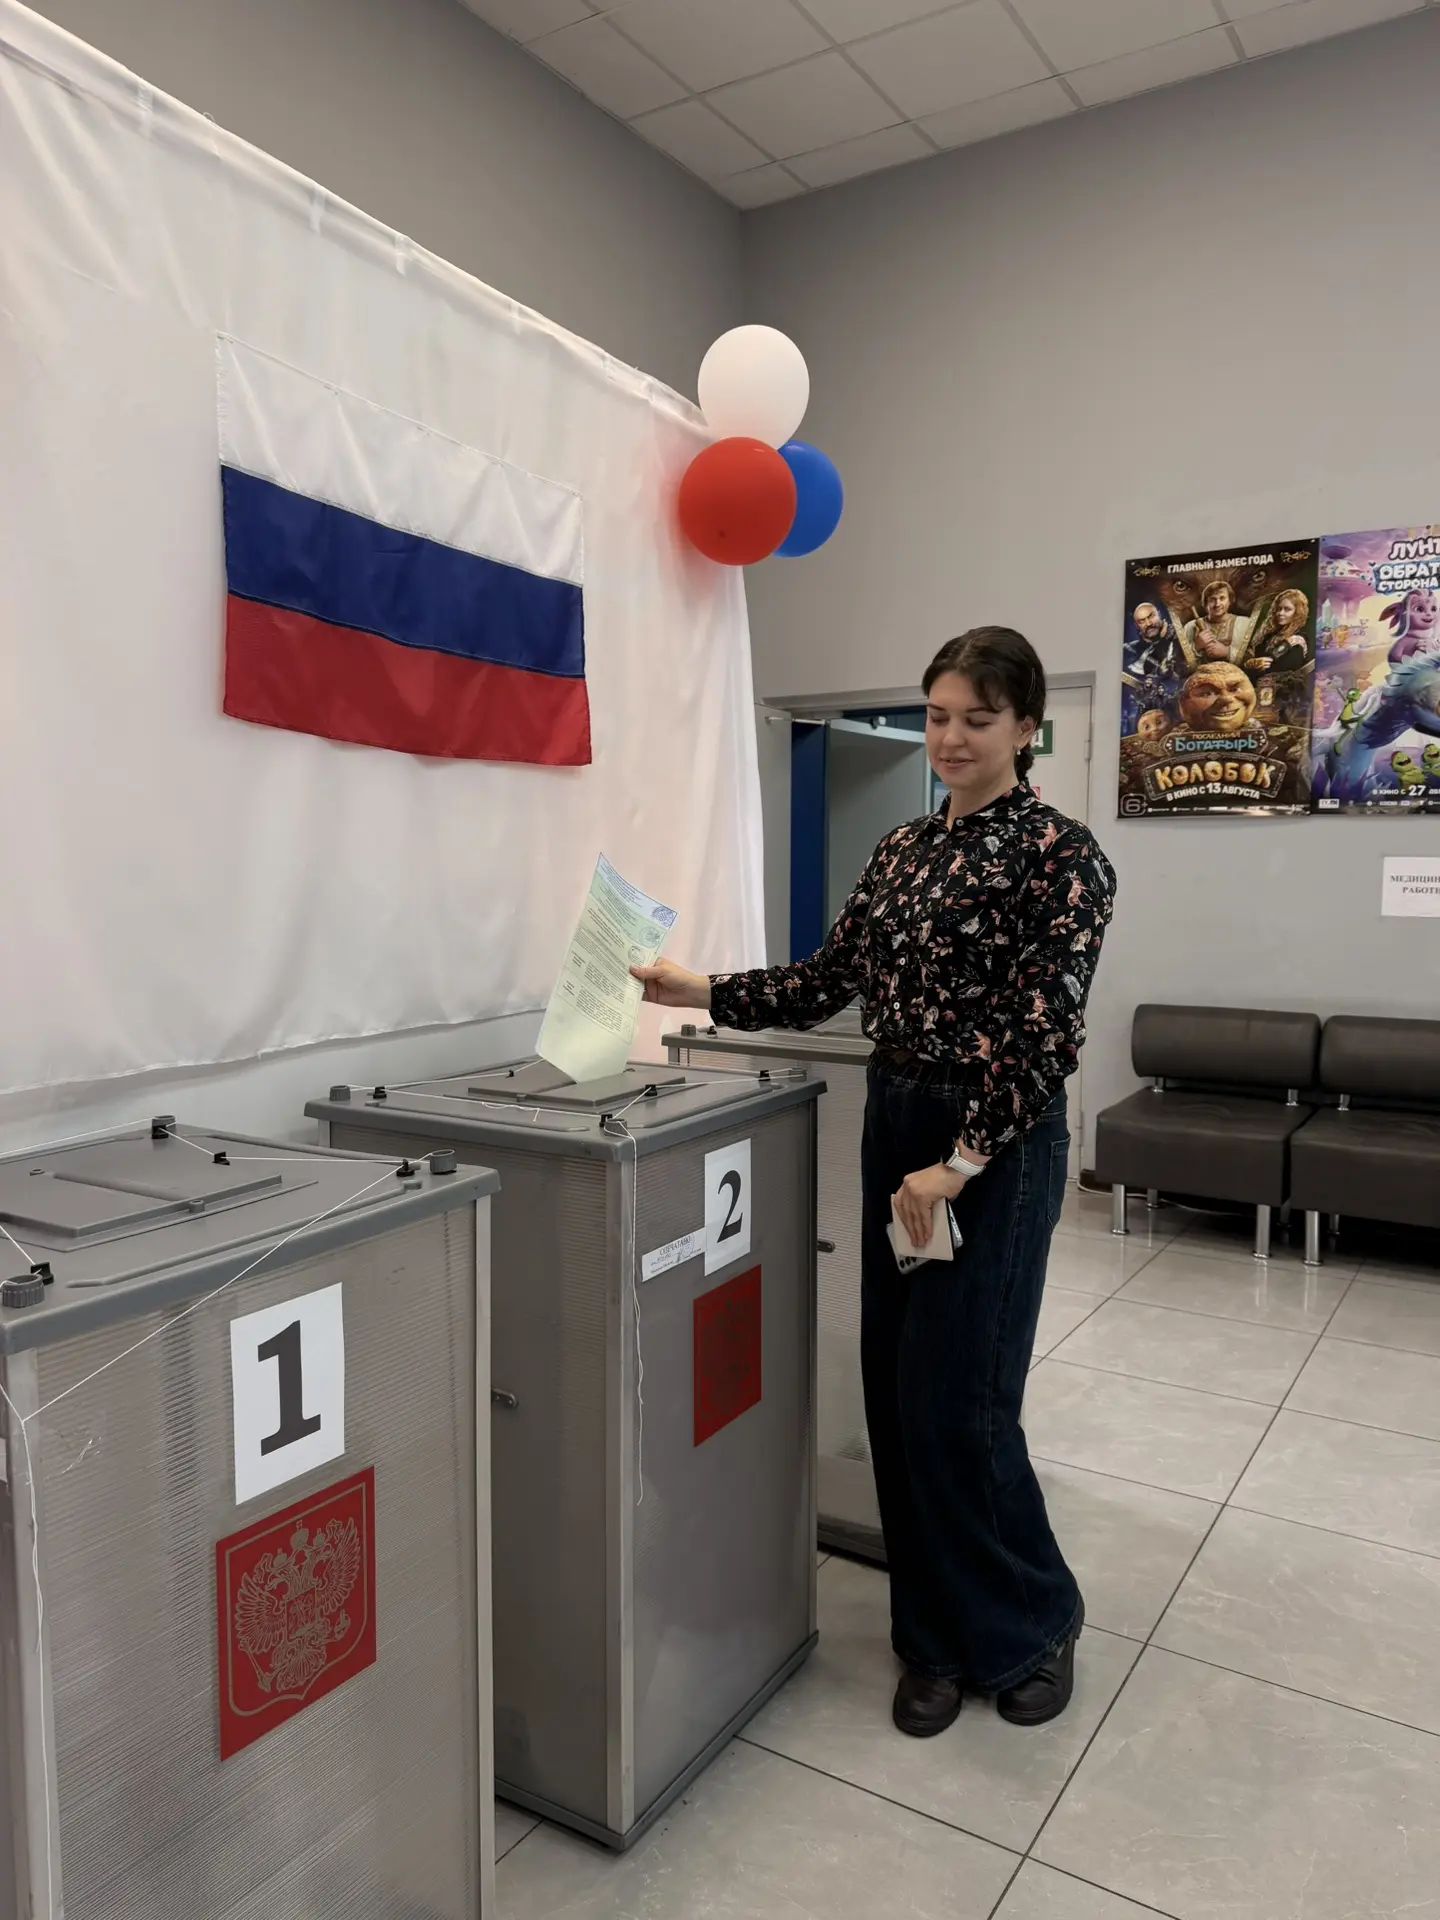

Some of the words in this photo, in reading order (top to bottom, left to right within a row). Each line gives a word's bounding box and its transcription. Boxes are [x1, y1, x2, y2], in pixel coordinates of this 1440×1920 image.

[1167, 559, 1214, 574] ГЛАВНЫЙ
[1215, 556, 1247, 569] ЗАМЕС
[1248, 553, 1274, 565] ГОДА
[1378, 577, 1439, 591] СТОРОНА
[1154, 760, 1276, 791] КОЛОБОК
[1166, 793, 1174, 801] В
[1174, 787, 1197, 799] КИНО
[1206, 782, 1221, 794] 13
[1222, 786, 1260, 799] АВГУСТА
[1408, 784, 1427, 796] 27
[716, 1169, 743, 1243] 2
[257, 1319, 321, 1457] 1
